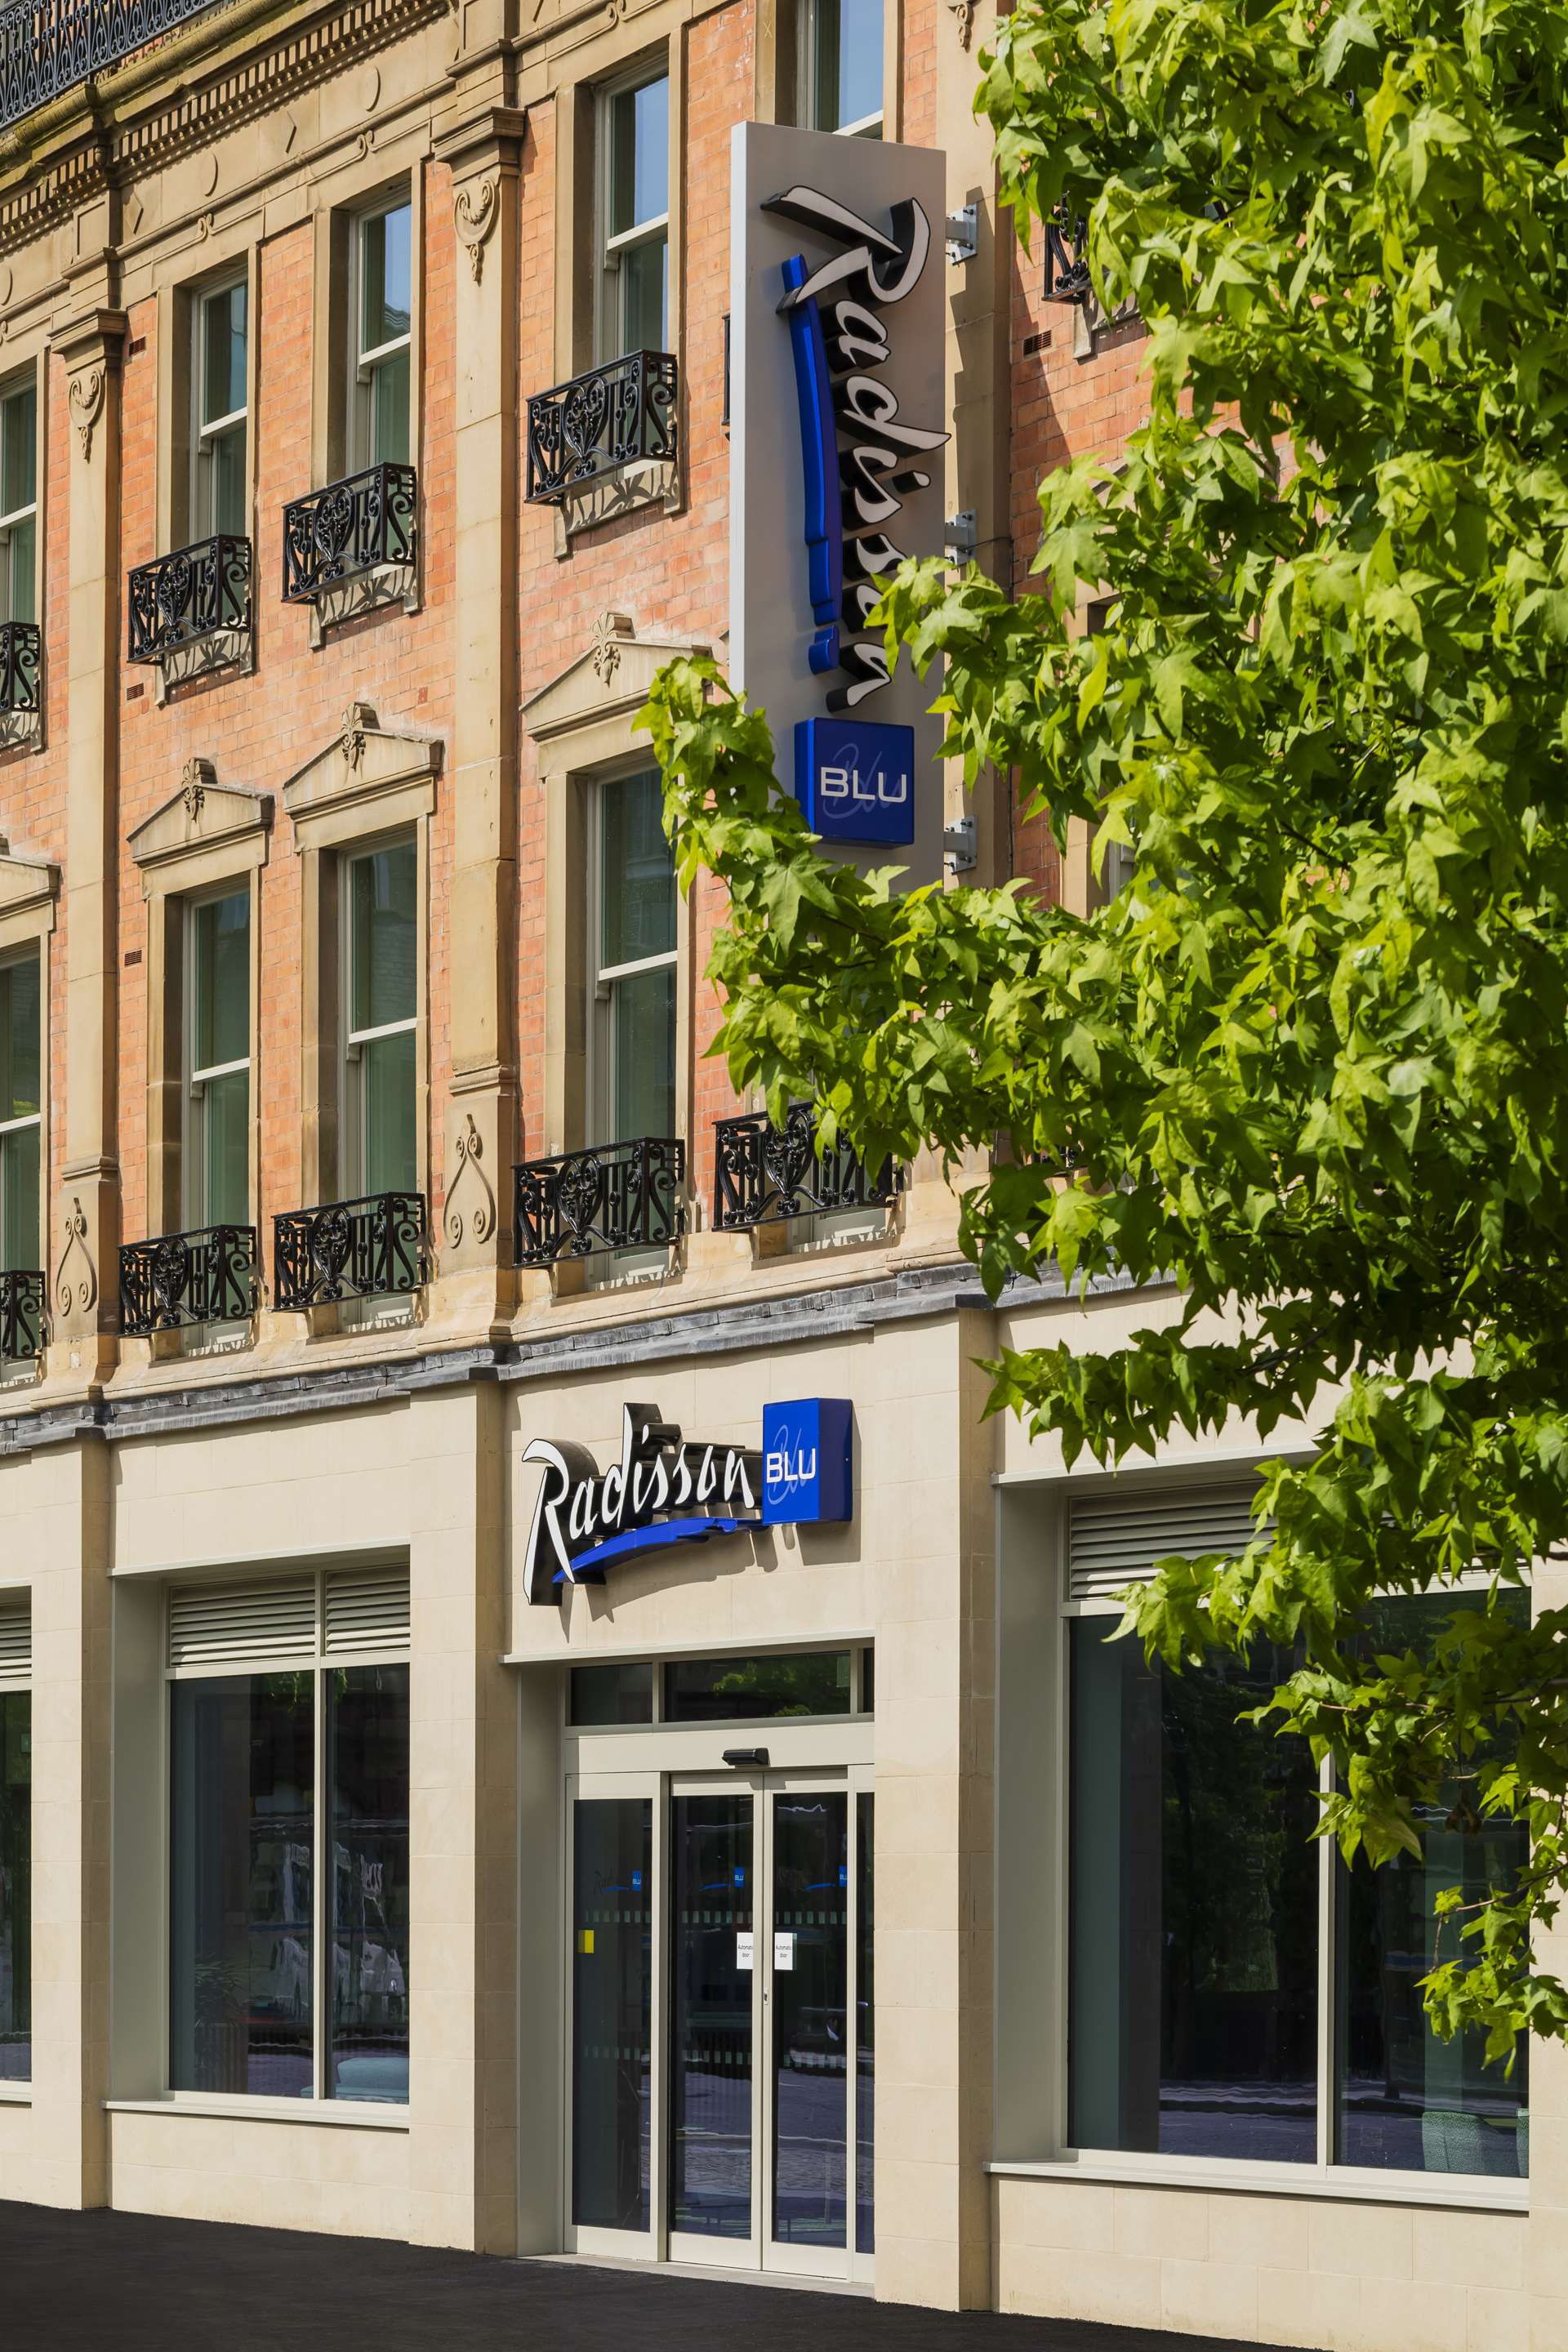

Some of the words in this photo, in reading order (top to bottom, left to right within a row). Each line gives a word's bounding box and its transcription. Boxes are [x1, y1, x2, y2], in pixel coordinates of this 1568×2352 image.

[820, 766, 907, 803] BLU
[522, 1402, 755, 1606] Radisson
[766, 1448, 816, 1483] BLU
